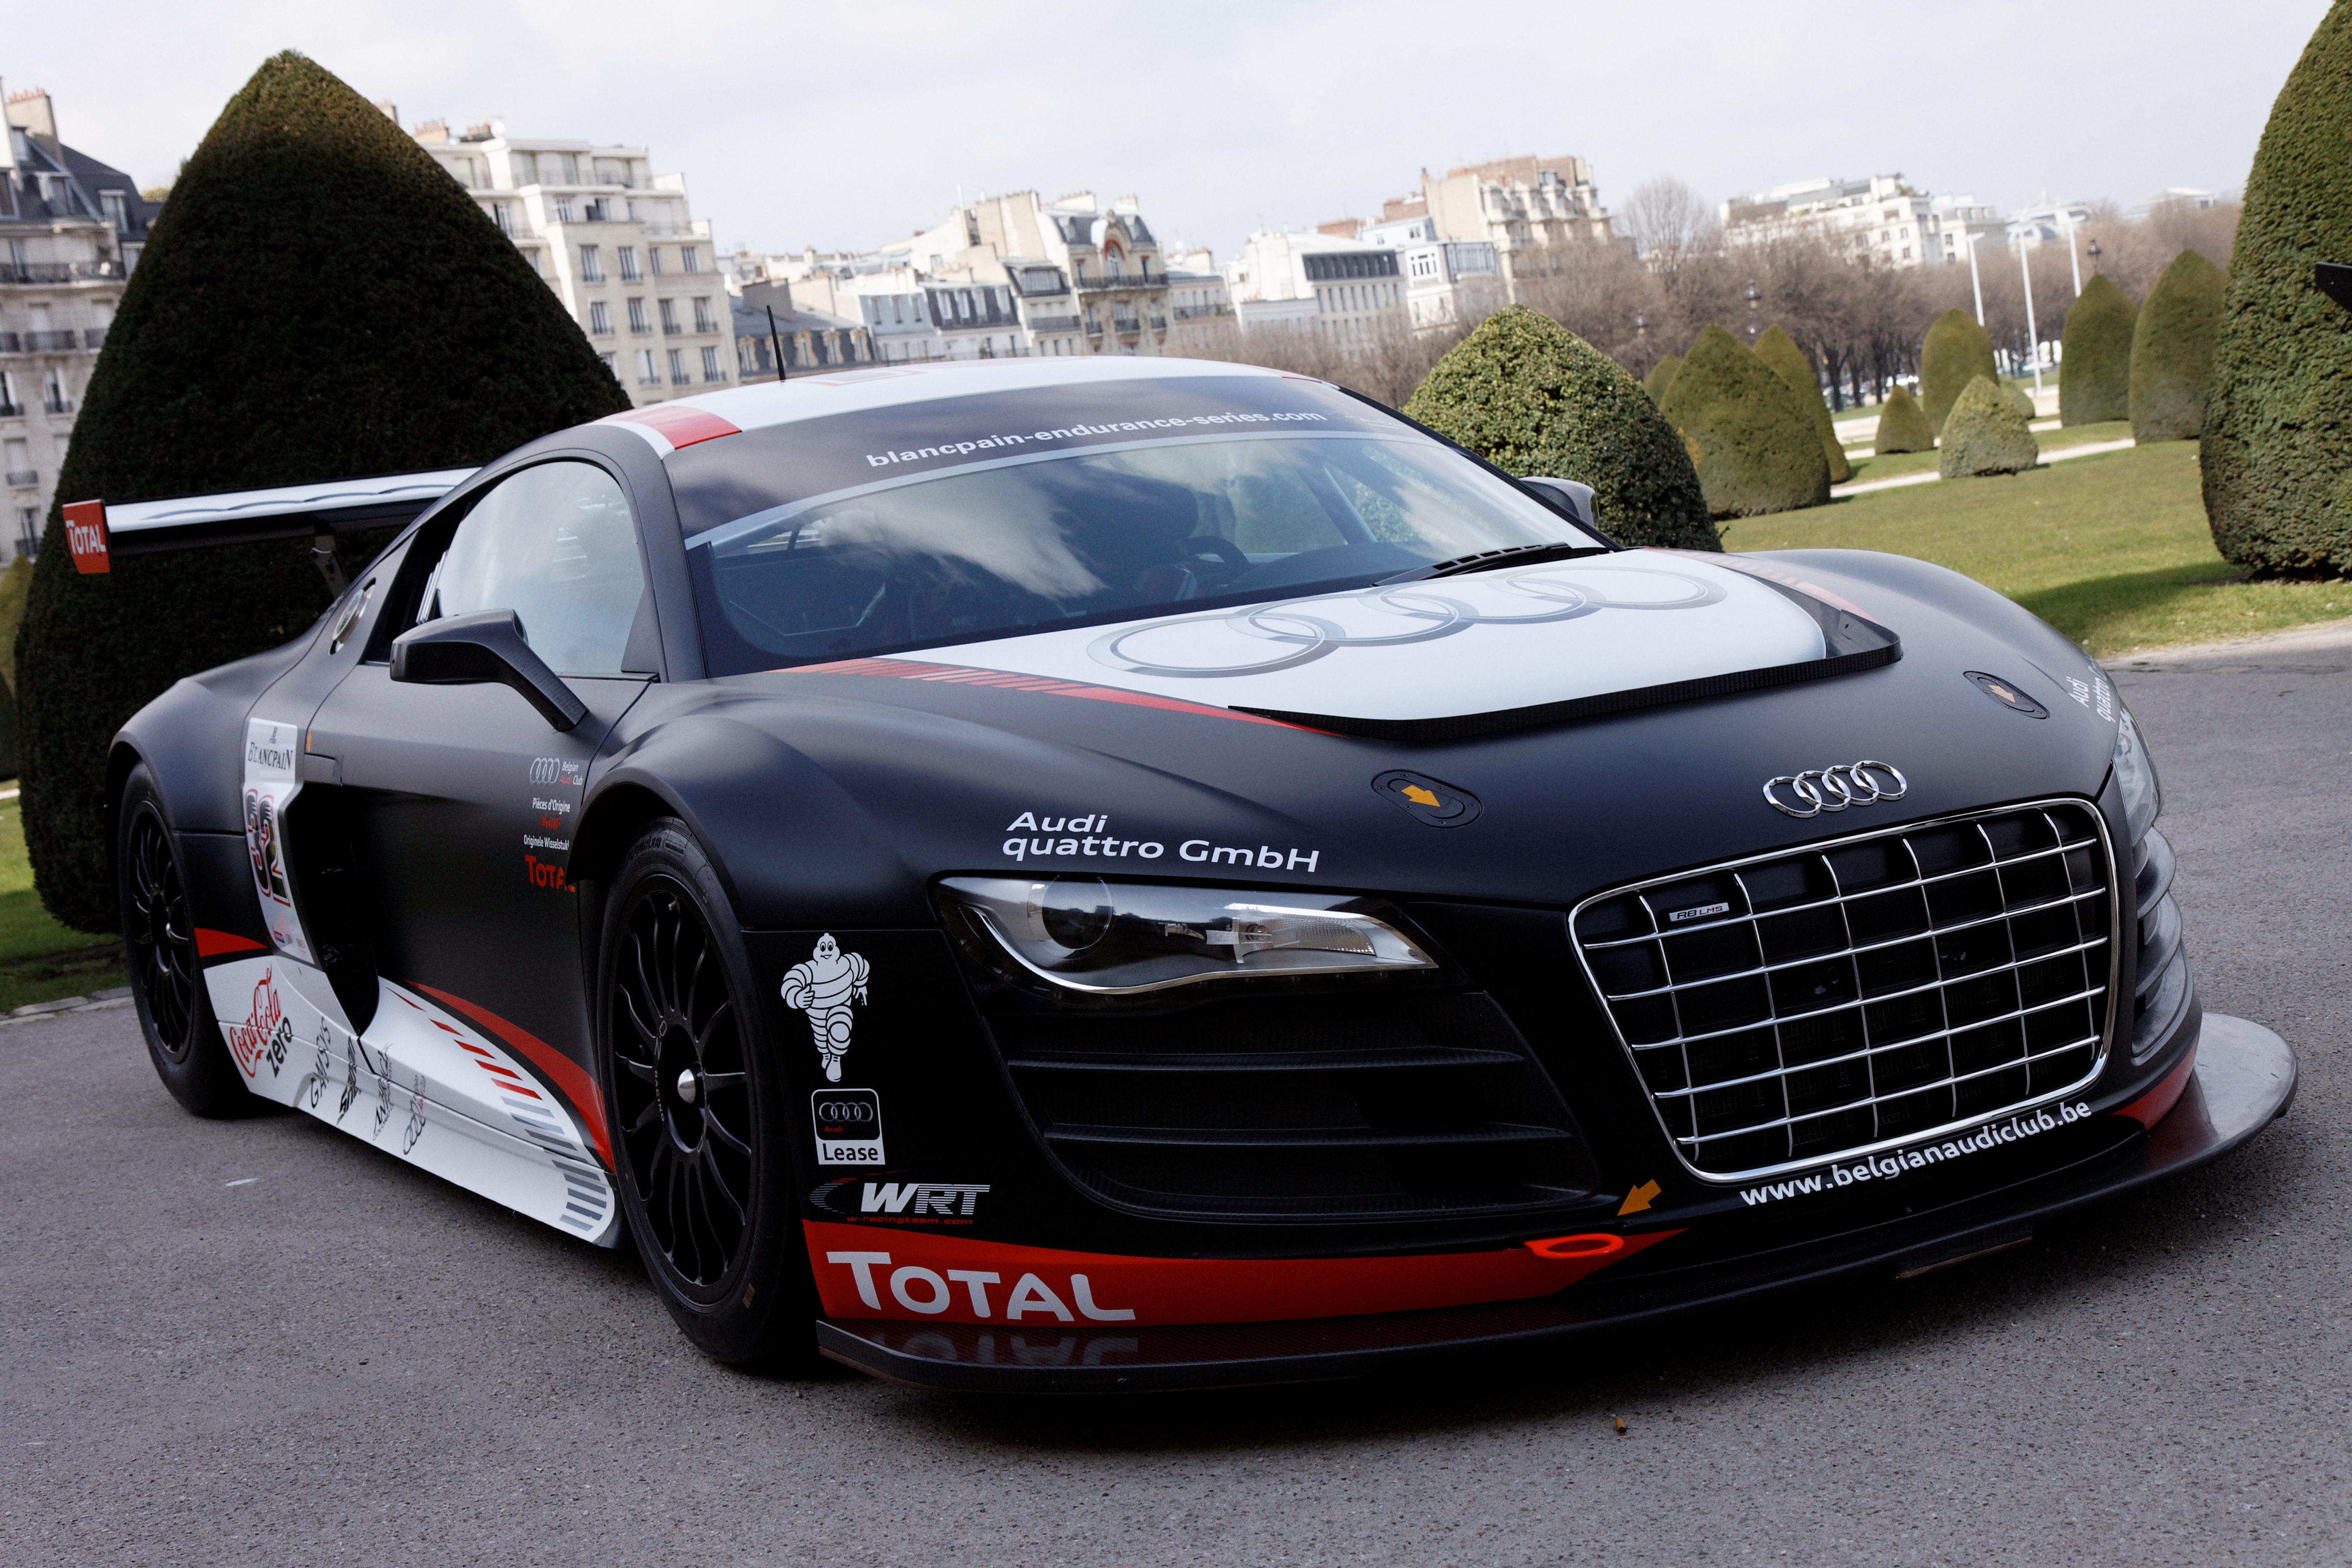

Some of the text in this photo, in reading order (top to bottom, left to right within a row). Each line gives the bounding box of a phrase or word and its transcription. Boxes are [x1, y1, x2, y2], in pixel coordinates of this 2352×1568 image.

[866, 411, 1327, 467] blancpain-endurance-series.com
[65, 520, 106, 555] TOTAL
[2066, 676, 2089, 708] Audi
[247, 741, 293, 770] BLANCPAIN
[562, 761, 579, 775] Belgian
[560, 774, 583, 785] Audi Club
[532, 797, 571, 815] Pièces d'Origine
[540, 813, 560, 830] Audi
[1007, 812, 1109, 833] Audi
[523, 834, 569, 851] Originele Wisselstuk
[1002, 835, 1319, 873] quattro GmbH
[1677, 906, 1723, 920] R8 LMS
[266, 1017, 292, 1078] zero
[823, 1143, 878, 1161] Lease
[1740, 1101, 2092, 1206] www.belgianaudiclub.be
[860, 1182, 990, 1215] WRT
[826, 1252, 1136, 1322] TOTAL
